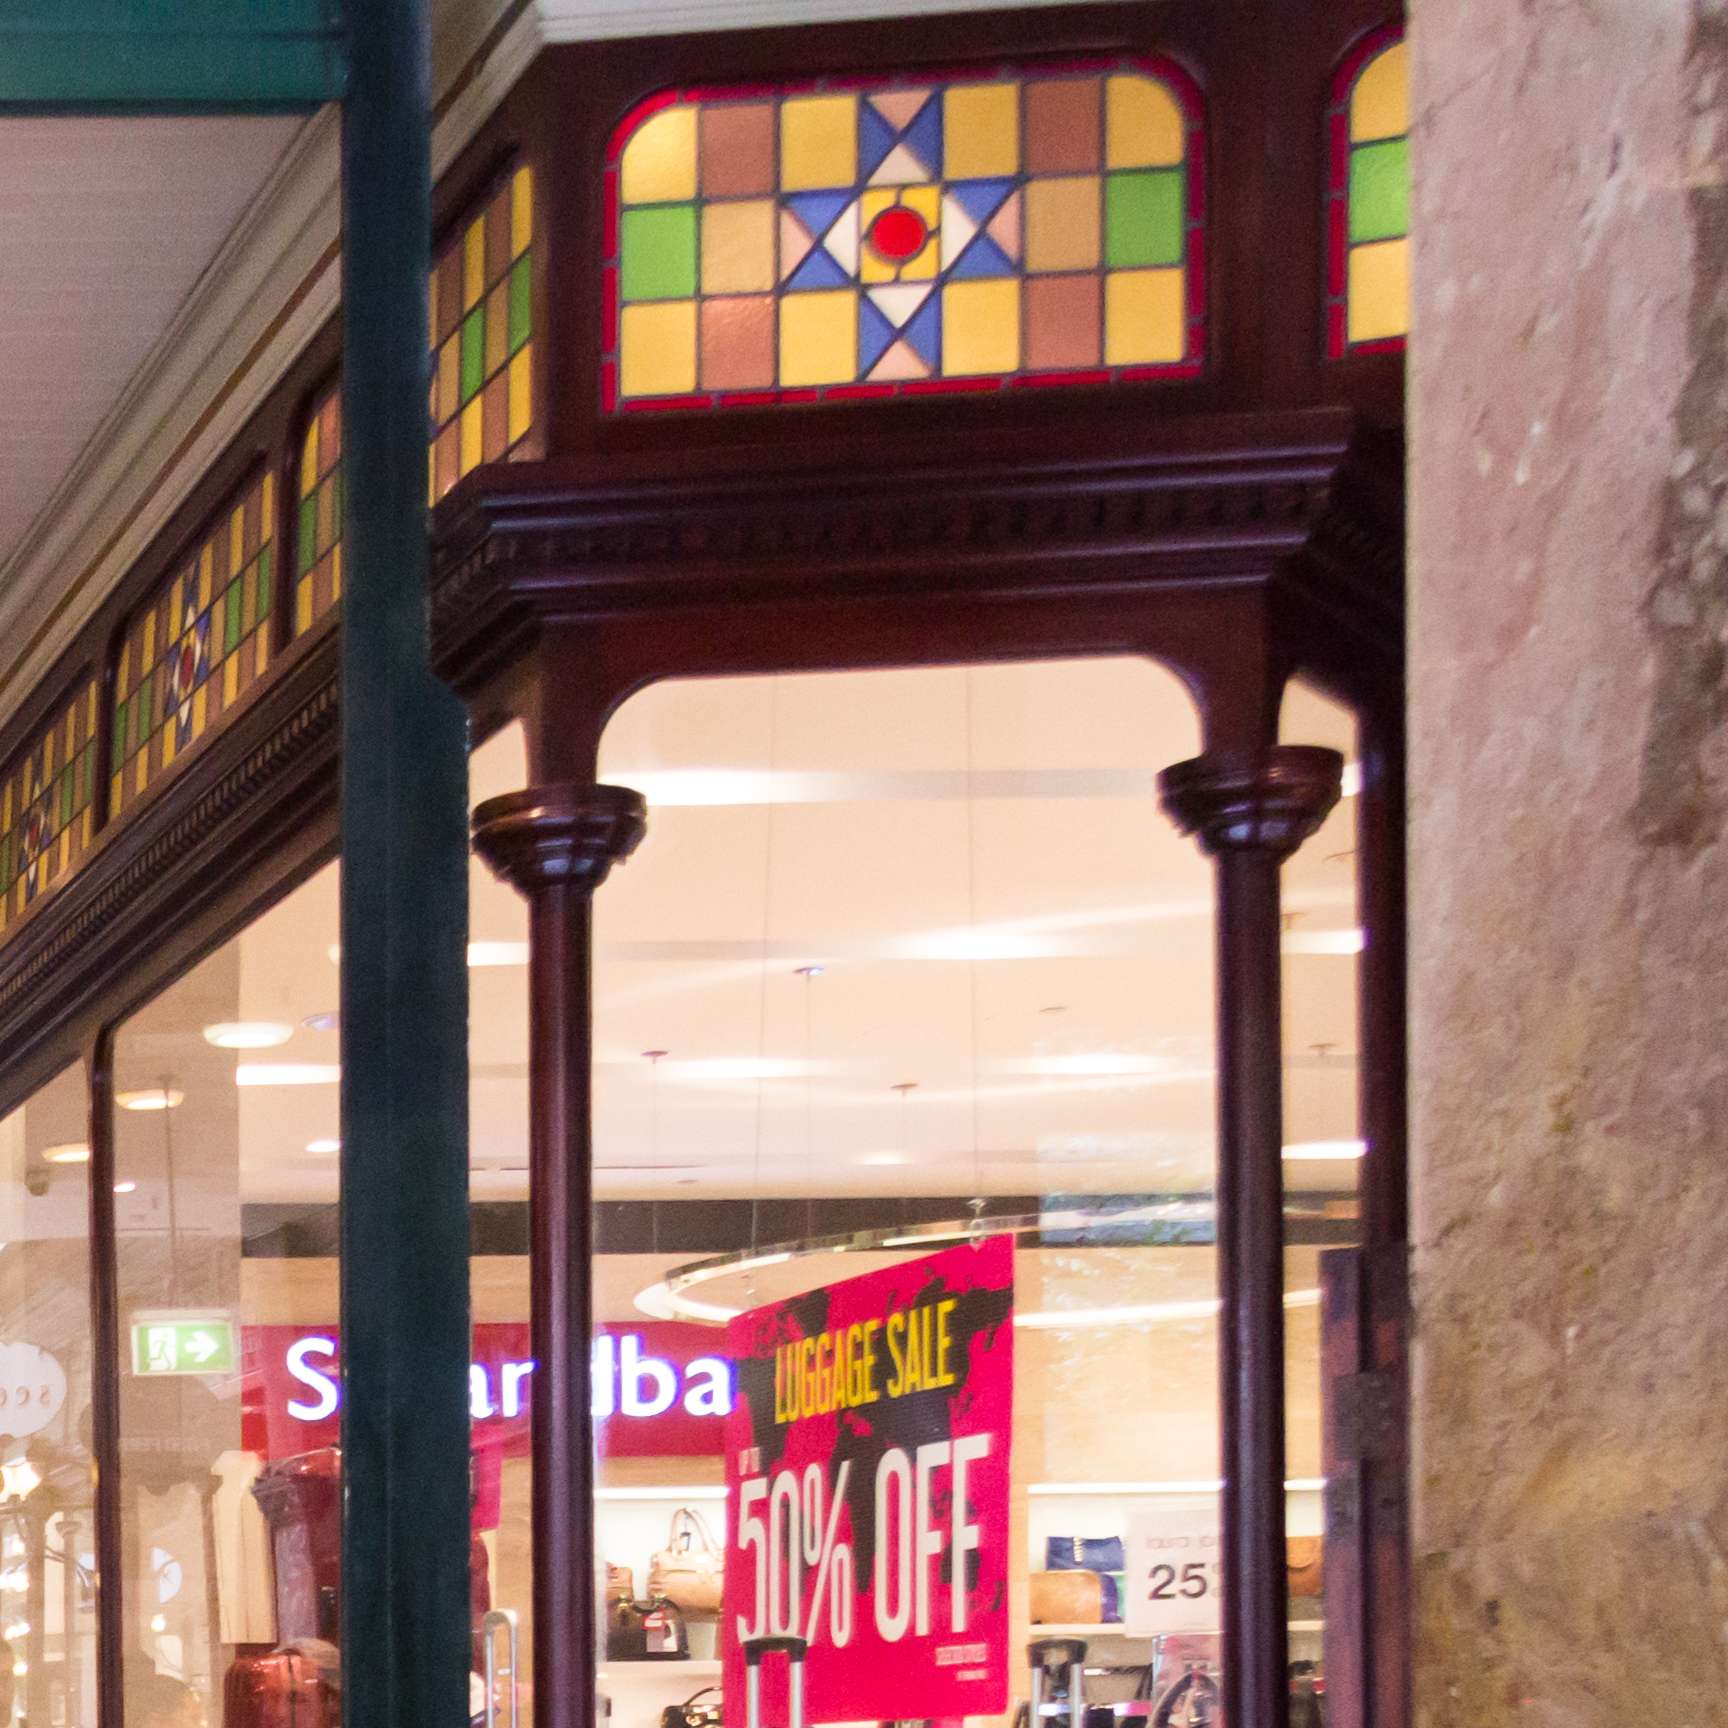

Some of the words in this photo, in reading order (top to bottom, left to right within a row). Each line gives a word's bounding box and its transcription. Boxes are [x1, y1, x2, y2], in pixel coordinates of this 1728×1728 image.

[774, 1318, 880, 1424] LUGGAGE
[886, 1299, 958, 1398] SALE
[737, 1459, 854, 1649] 50%
[874, 1433, 992, 1643] OFF
